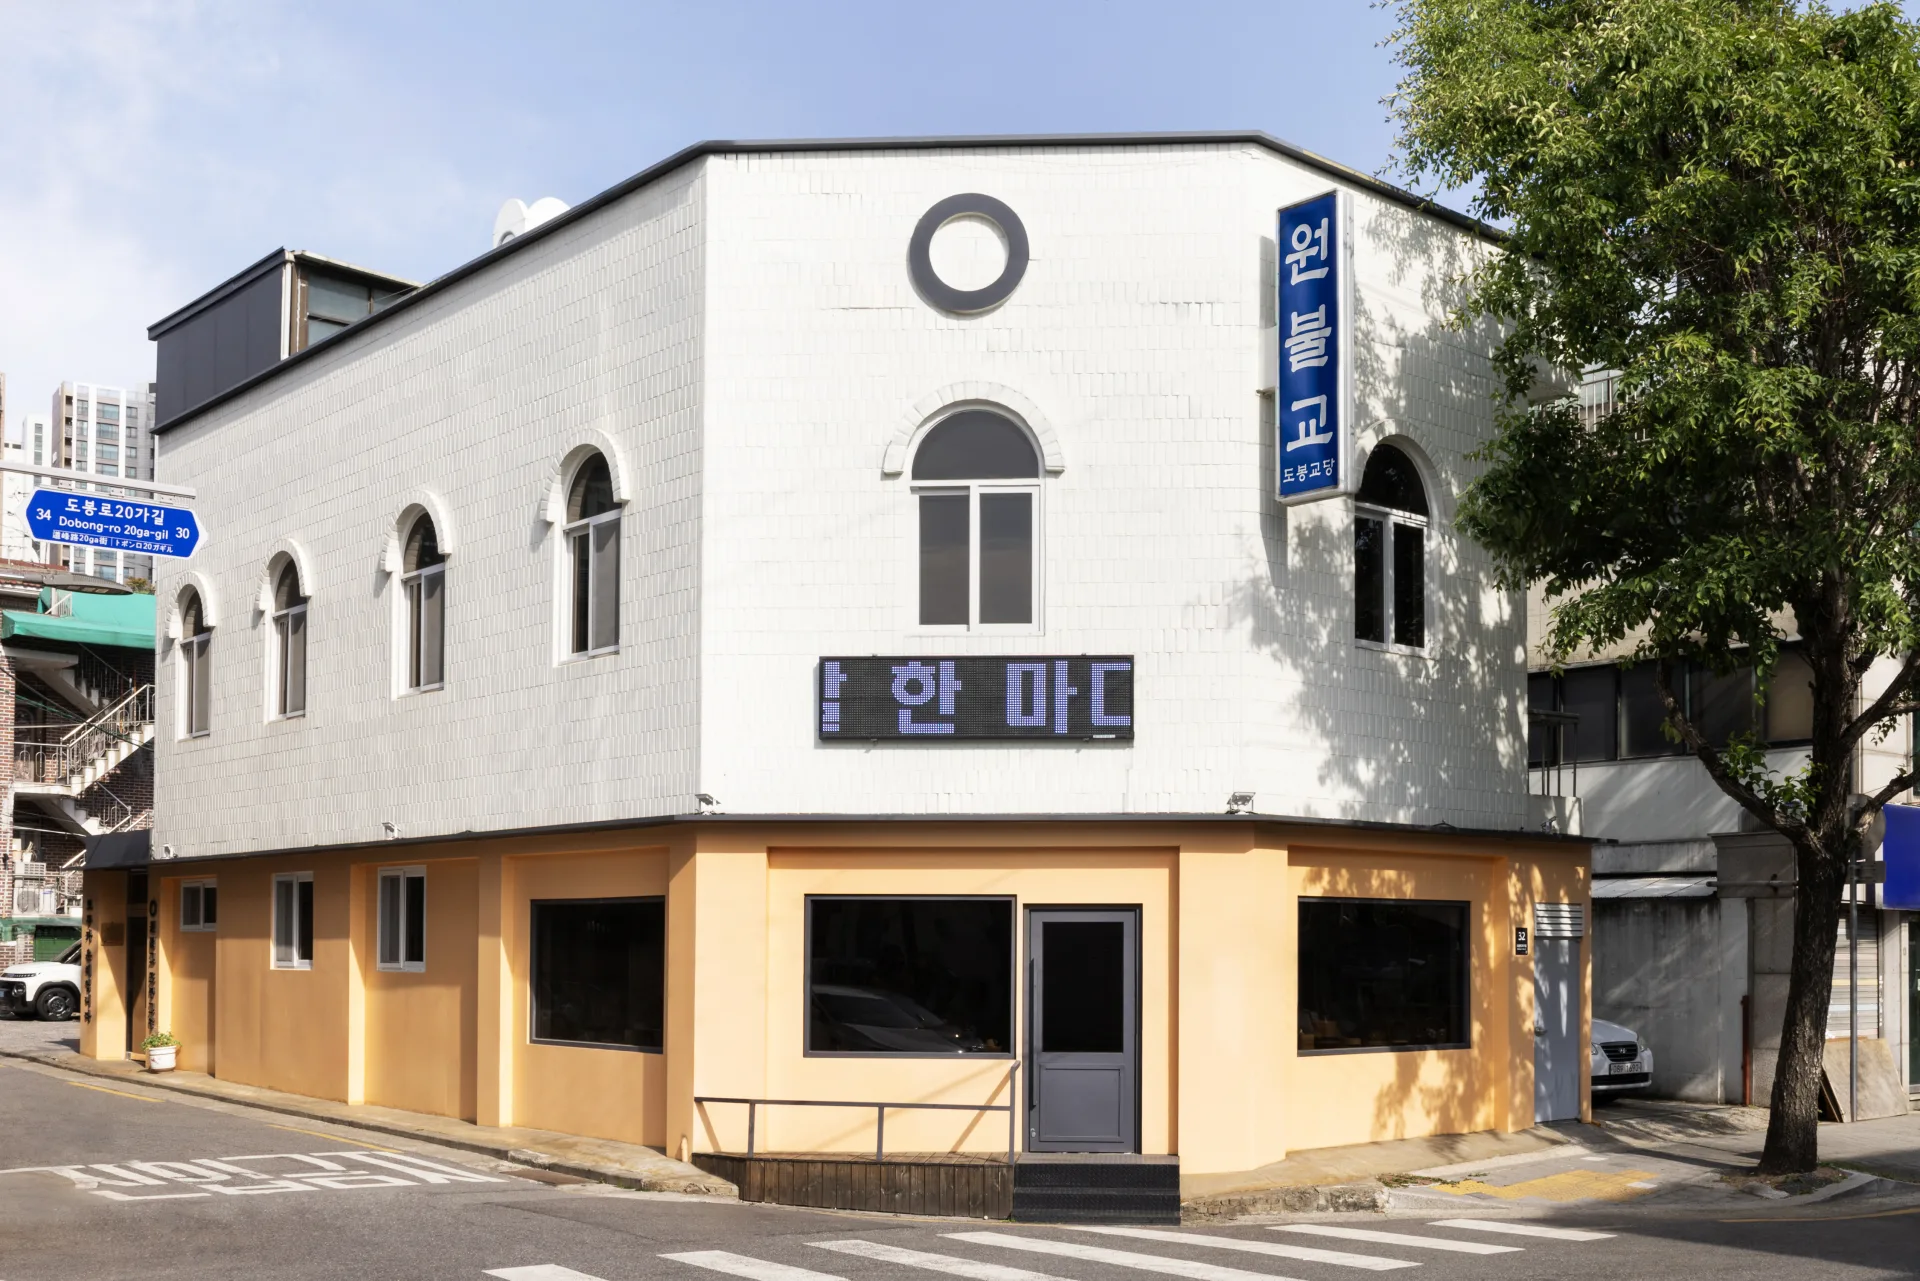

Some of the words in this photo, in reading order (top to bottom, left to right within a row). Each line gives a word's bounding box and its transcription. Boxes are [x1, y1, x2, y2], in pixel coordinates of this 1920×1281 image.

[1284, 216, 1334, 454] 원불교
[1282, 457, 1336, 484] 도봉교당
[36, 508, 52, 521] 34
[65, 497, 165, 526] 도봉로20가길
[59, 516, 121, 534] Dobong-ro
[124, 524, 169, 541] 20ga-gil
[175, 527, 190, 539] 30
[891, 661, 962, 734] 한
[1518, 931, 1526, 941] 32
